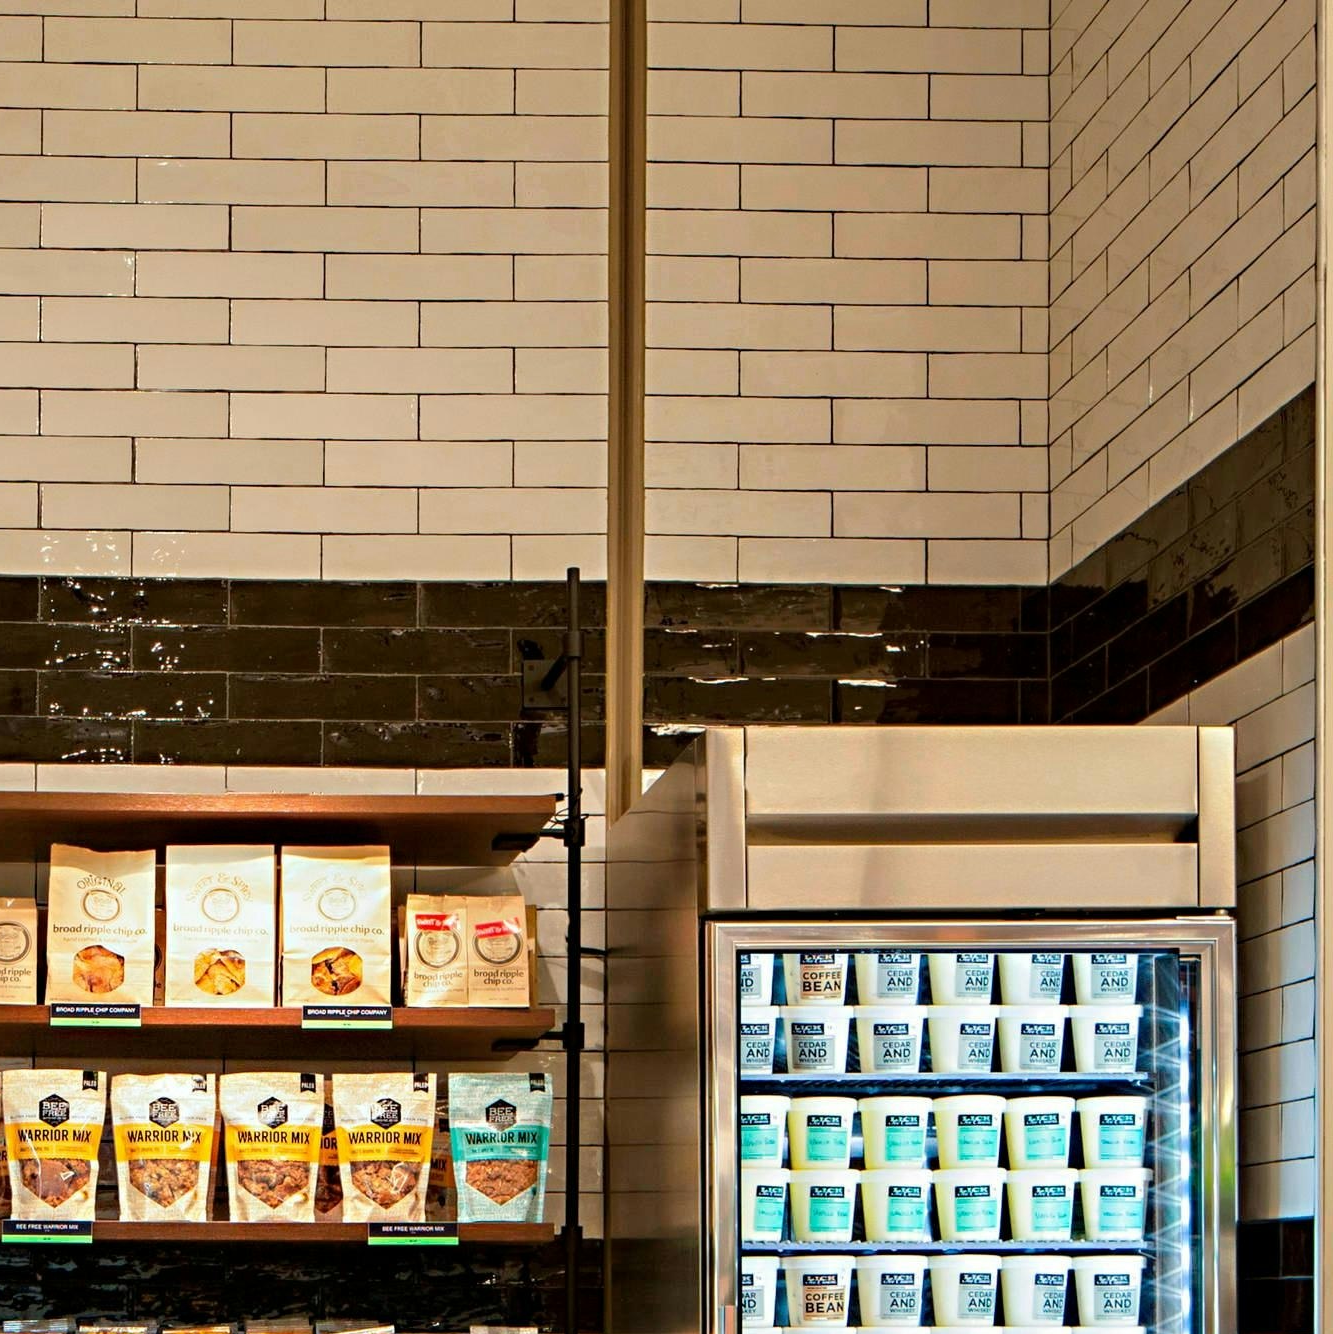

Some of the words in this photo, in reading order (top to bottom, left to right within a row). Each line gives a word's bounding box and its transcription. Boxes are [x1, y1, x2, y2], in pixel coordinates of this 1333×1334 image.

[76, 873, 127, 896] ORIGINAL
[52, 924, 82, 934] broad
[83, 925, 111, 936] ripple
[112, 925, 134, 936] chip
[135, 928, 147, 936] co.
[289, 924, 319, 934] broad
[320, 924, 351, 935] ripple
[352, 924, 371, 935] chip
[372, 926, 385, 935] co.
[8, 968, 32, 978] ripple
[473, 970, 496, 980] broad
[498, 971, 524, 981] ripple
[802, 972, 841, 980] COFFEE
[10, 975, 21, 983] co.
[483, 976, 501, 986] chip
[502, 977, 514, 985] co.
[888, 977, 913, 986] AND
[1101, 977, 1129, 987] AND
[802, 981, 841, 992] BEAN
[75, 1006, 94, 1014] RIPPLE
[327, 1009, 346, 1017] RIPPLE
[799, 1049, 827, 1058] AND
[83, 1080, 97, 1088] PALEO
[42, 1101, 67, 1110] BEE
[152, 1103, 176, 1111] BEE
[42, 1109, 68, 1117] FREE
[152, 1111, 177, 1119] FREE
[489, 1107, 513, 1115] BEE
[489, 1114, 516, 1123] FREE
[18, 1129, 70, 1142] WARRIOR
[73, 1128, 92, 1143] MIX
[128, 1130, 179, 1143] WARRIOR
[237, 1131, 288, 1143] WARRIOR
[291, 1130, 310, 1144] MIX
[348, 1131, 400, 1144] WARRIOR
[403, 1131, 422, 1145] MIX
[465, 1132, 514, 1144] WARRIOR
[518, 1131, 538, 1143] MIX
[805, 1293, 844, 1301] COFFEE
[805, 1302, 844, 1313] BEAN
